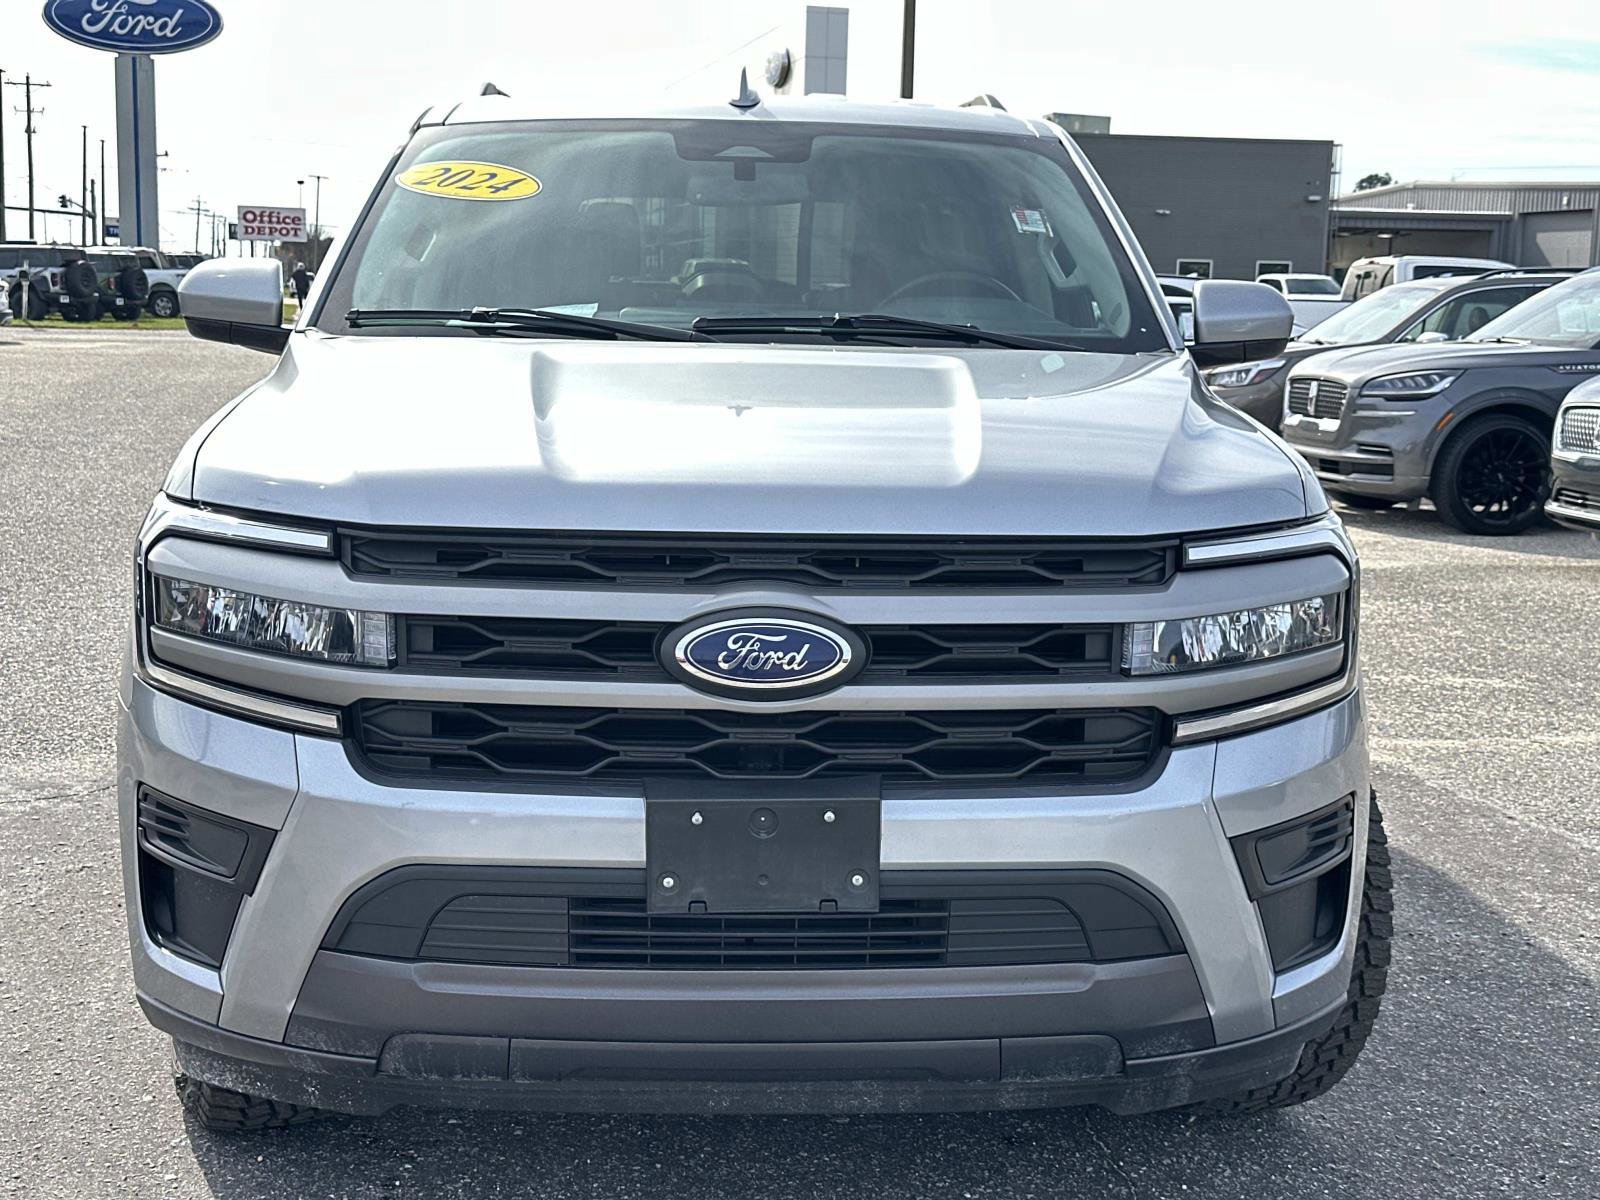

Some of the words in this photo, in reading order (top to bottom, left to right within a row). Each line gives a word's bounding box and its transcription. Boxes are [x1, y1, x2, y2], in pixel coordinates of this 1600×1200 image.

[81, 0, 184, 38] Ford
[412, 167, 528, 194] 2024
[242, 210, 302, 226] Office
[243, 225, 302, 237] DEPOT
[717, 632, 811, 671] Ford
